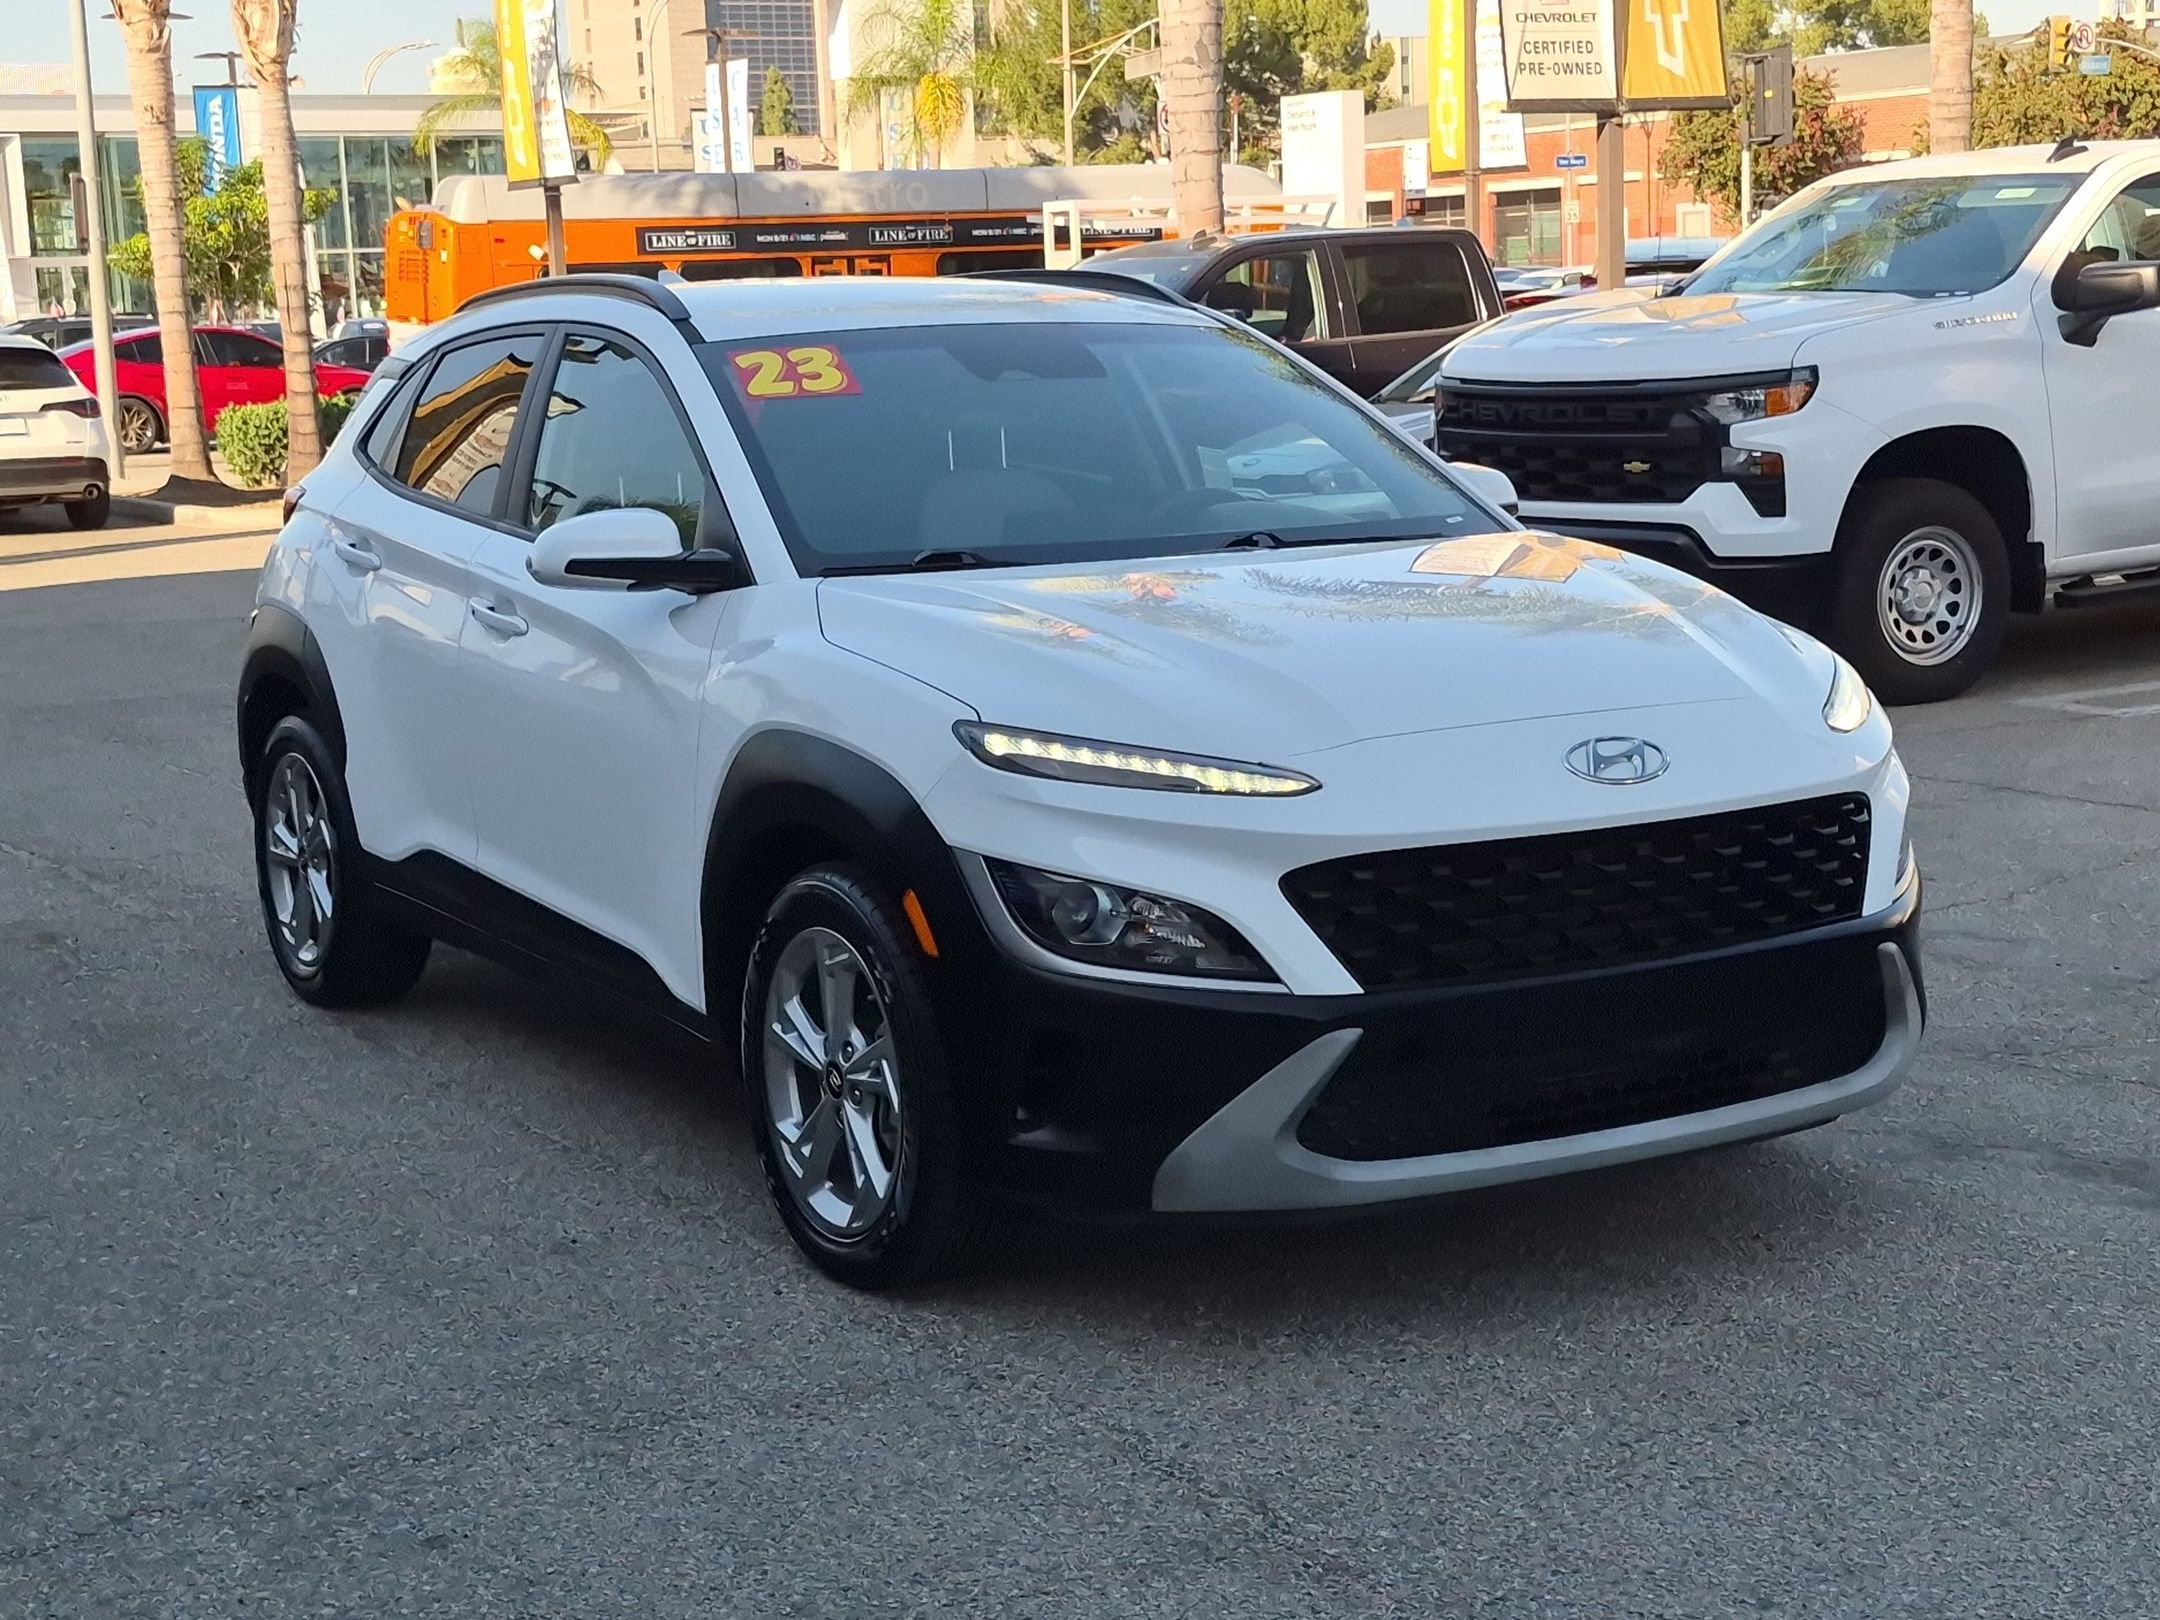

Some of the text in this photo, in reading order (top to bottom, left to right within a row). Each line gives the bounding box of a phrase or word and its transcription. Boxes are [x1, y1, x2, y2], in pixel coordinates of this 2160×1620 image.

[1515, 12, 1597, 23] CHEVROLET
[1523, 40, 1594, 54] CERTIFIED
[1519, 62, 1603, 75] PRE-OWNED
[652, 235, 687, 248] LINE
[698, 234, 732, 247] FIRE
[875, 230, 907, 241] LINE
[917, 229, 949, 240] FIRE
[734, 346, 848, 398] 23
